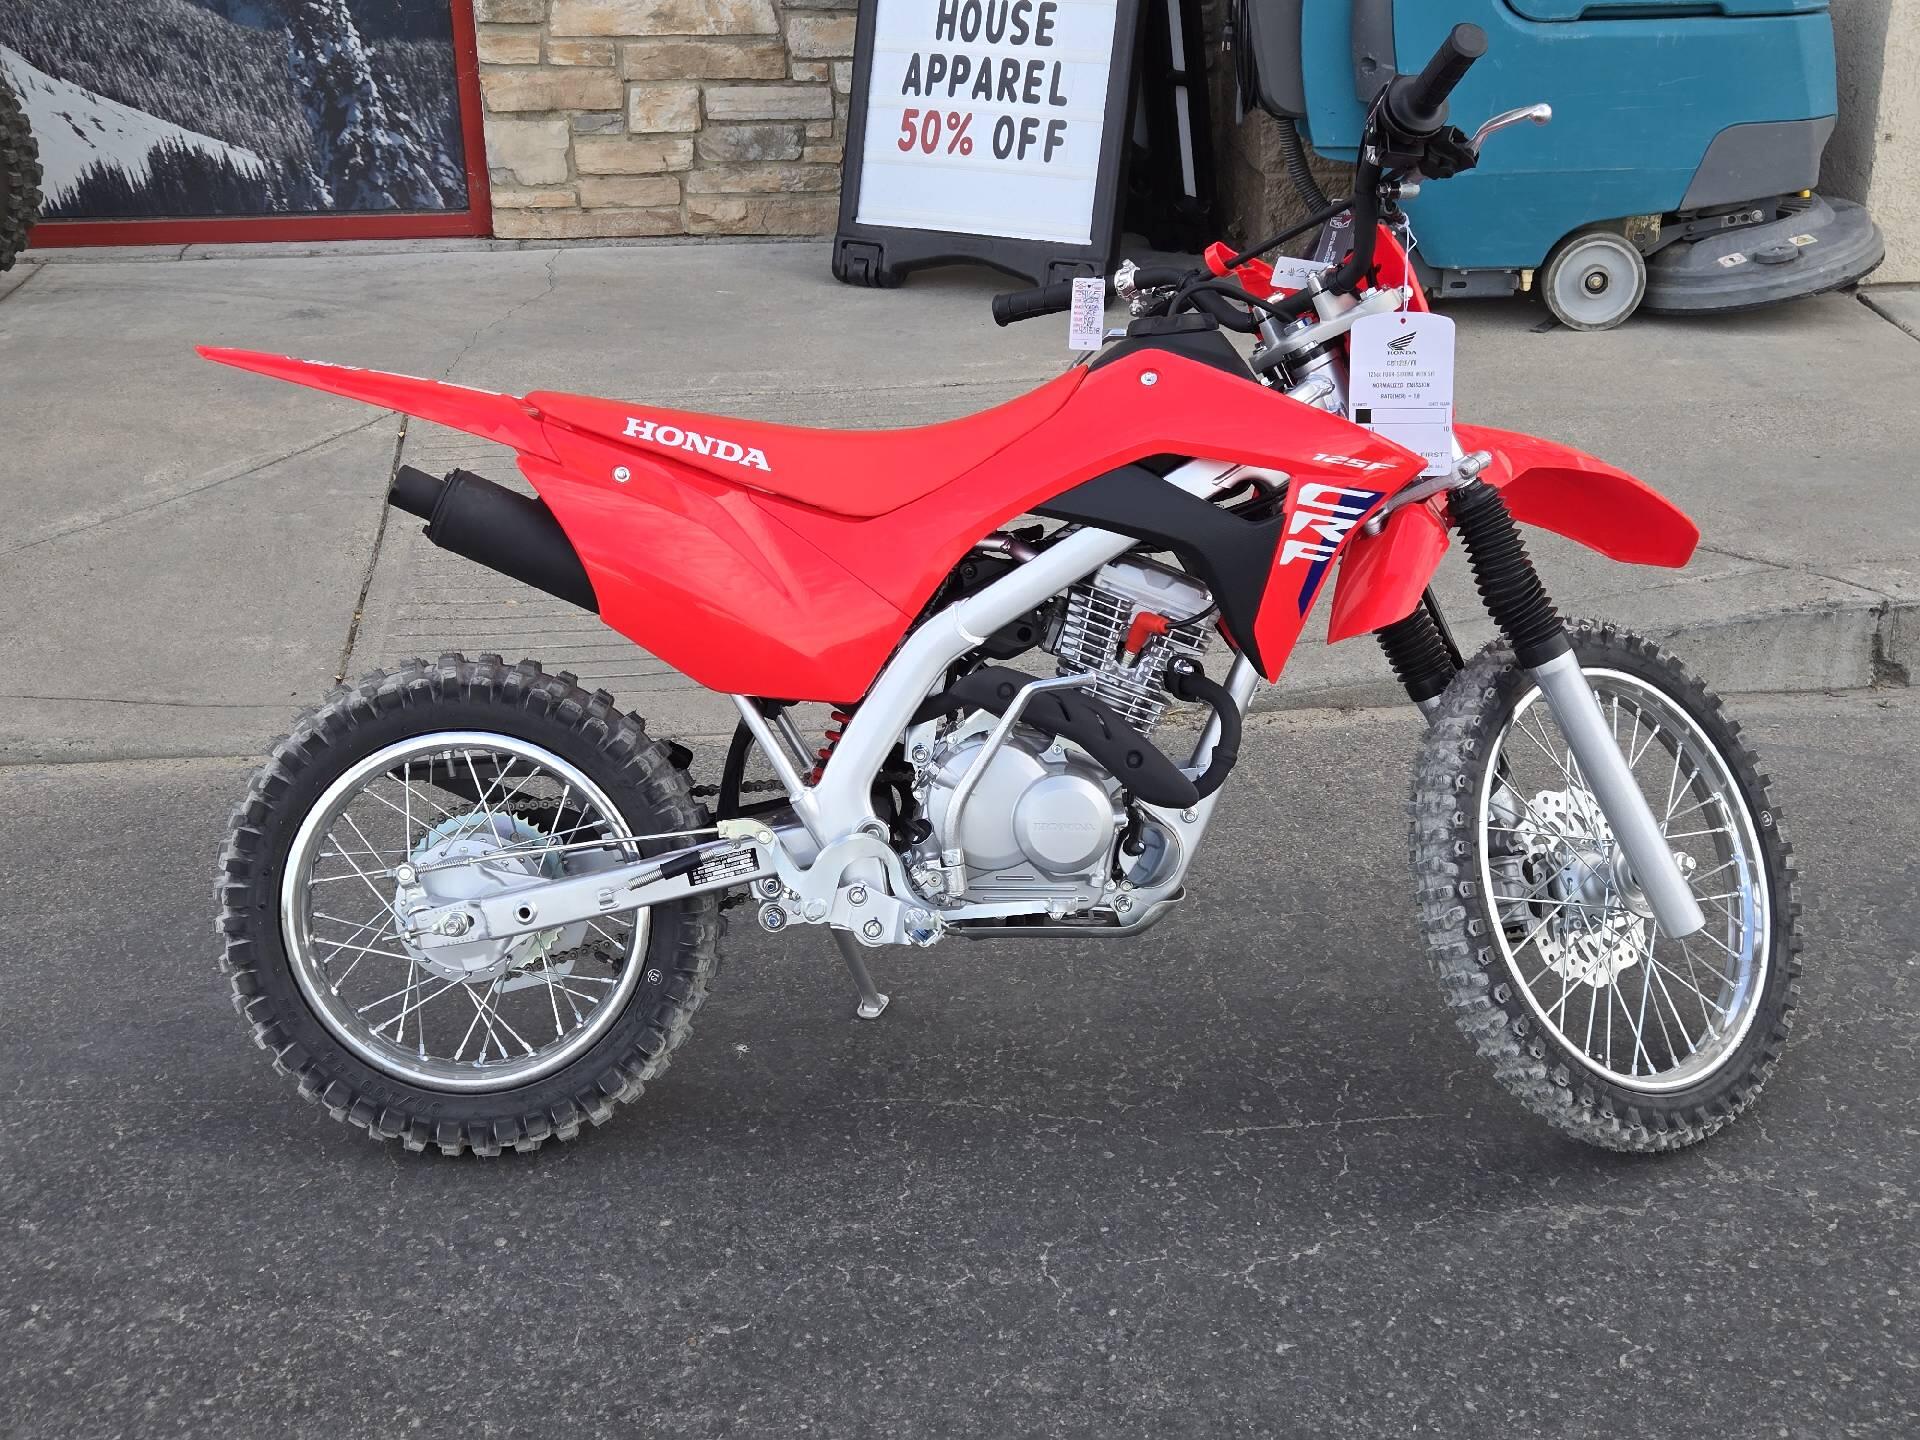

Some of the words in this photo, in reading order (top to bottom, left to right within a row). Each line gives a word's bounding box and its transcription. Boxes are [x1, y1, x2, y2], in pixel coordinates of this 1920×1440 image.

[935, 0, 1057, 46] HOUSE
[902, 53, 1067, 106] APPAREL
[898, 109, 973, 155] 50%
[992, 115, 1067, 163] OFF
[622, 417, 772, 472] HONDA
[1312, 453, 1399, 471] 125F
